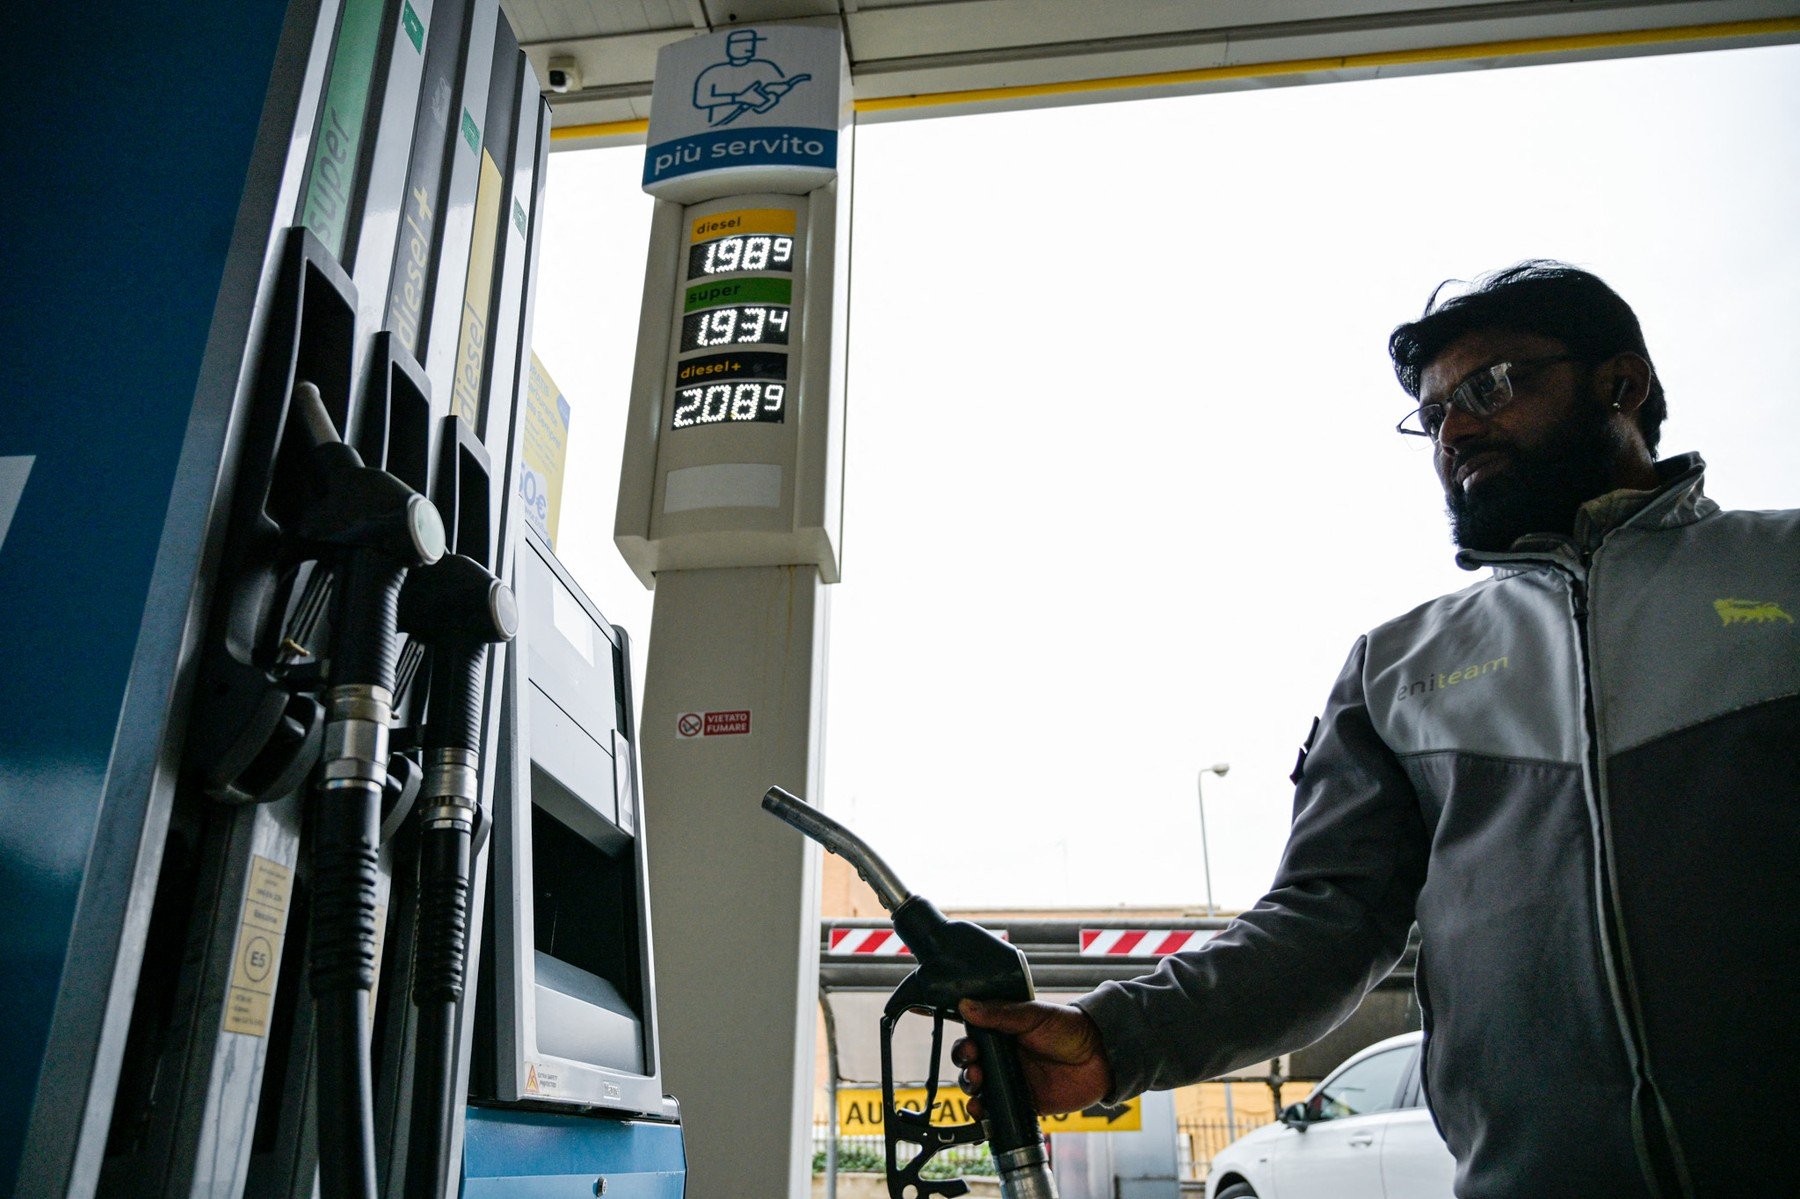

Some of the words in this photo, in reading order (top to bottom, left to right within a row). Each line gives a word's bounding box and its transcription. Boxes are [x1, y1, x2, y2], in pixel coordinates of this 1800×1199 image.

[655, 142, 701, 176] più
[711, 134, 824, 158] servito
[309, 106, 350, 244] super
[697, 217, 741, 235] diesel
[689, 284, 741, 303] super
[455, 301, 485, 427] diesel
[1397, 656, 1509, 701] eniteam
[707, 713, 747, 723] VIETATO
[707, 723, 747, 733] FUMARE
[250, 950, 267, 968] E5
